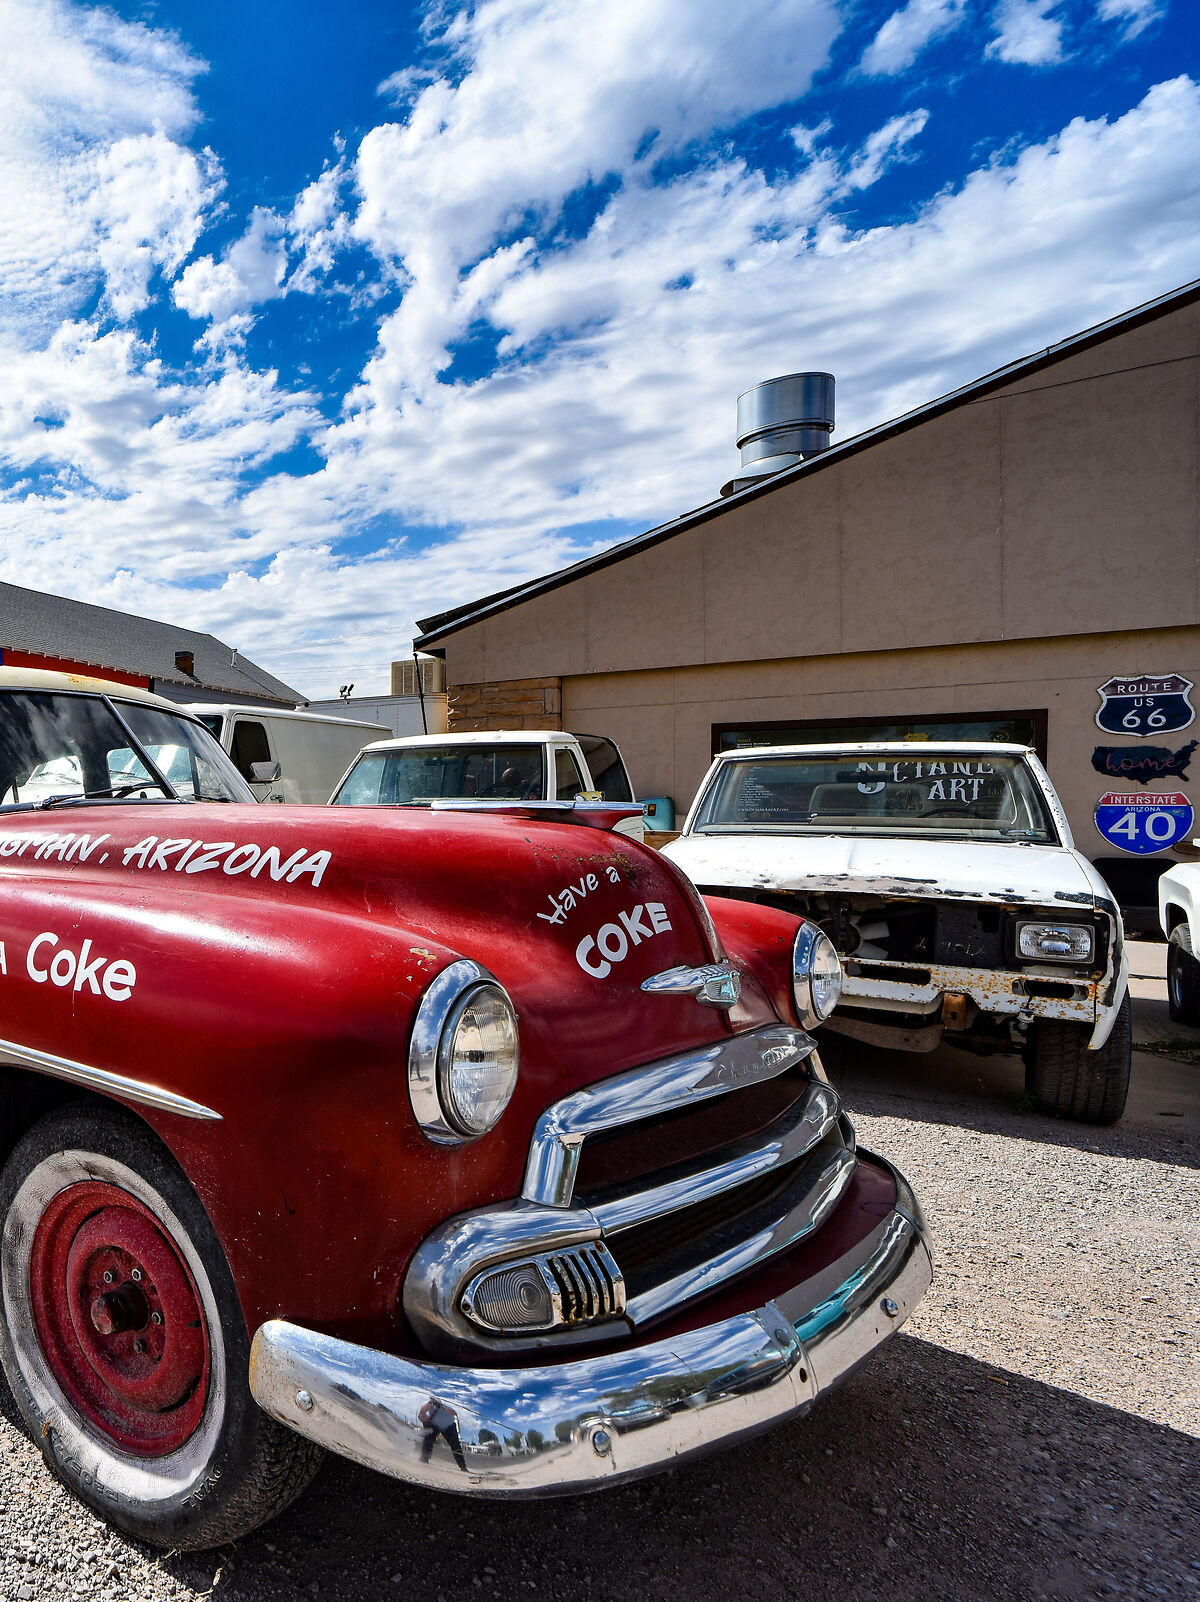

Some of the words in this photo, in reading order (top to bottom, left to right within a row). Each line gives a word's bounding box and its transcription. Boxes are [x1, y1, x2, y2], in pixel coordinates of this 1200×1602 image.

[1117, 682, 1172, 694] ROUTE
[1134, 697, 1154, 707] US
[1122, 708, 1167, 729] 66
[1104, 753, 1182, 773] home
[928, 778, 985, 807] ART
[1110, 795, 1177, 805] INTERSTATE
[1108, 812, 1176, 841] 40
[121, 835, 332, 888] ARIZONA
[536, 872, 599, 926] Have
[605, 865, 621, 884] a
[575, 901, 673, 979] COKE
[26, 931, 137, 1002] Coke
